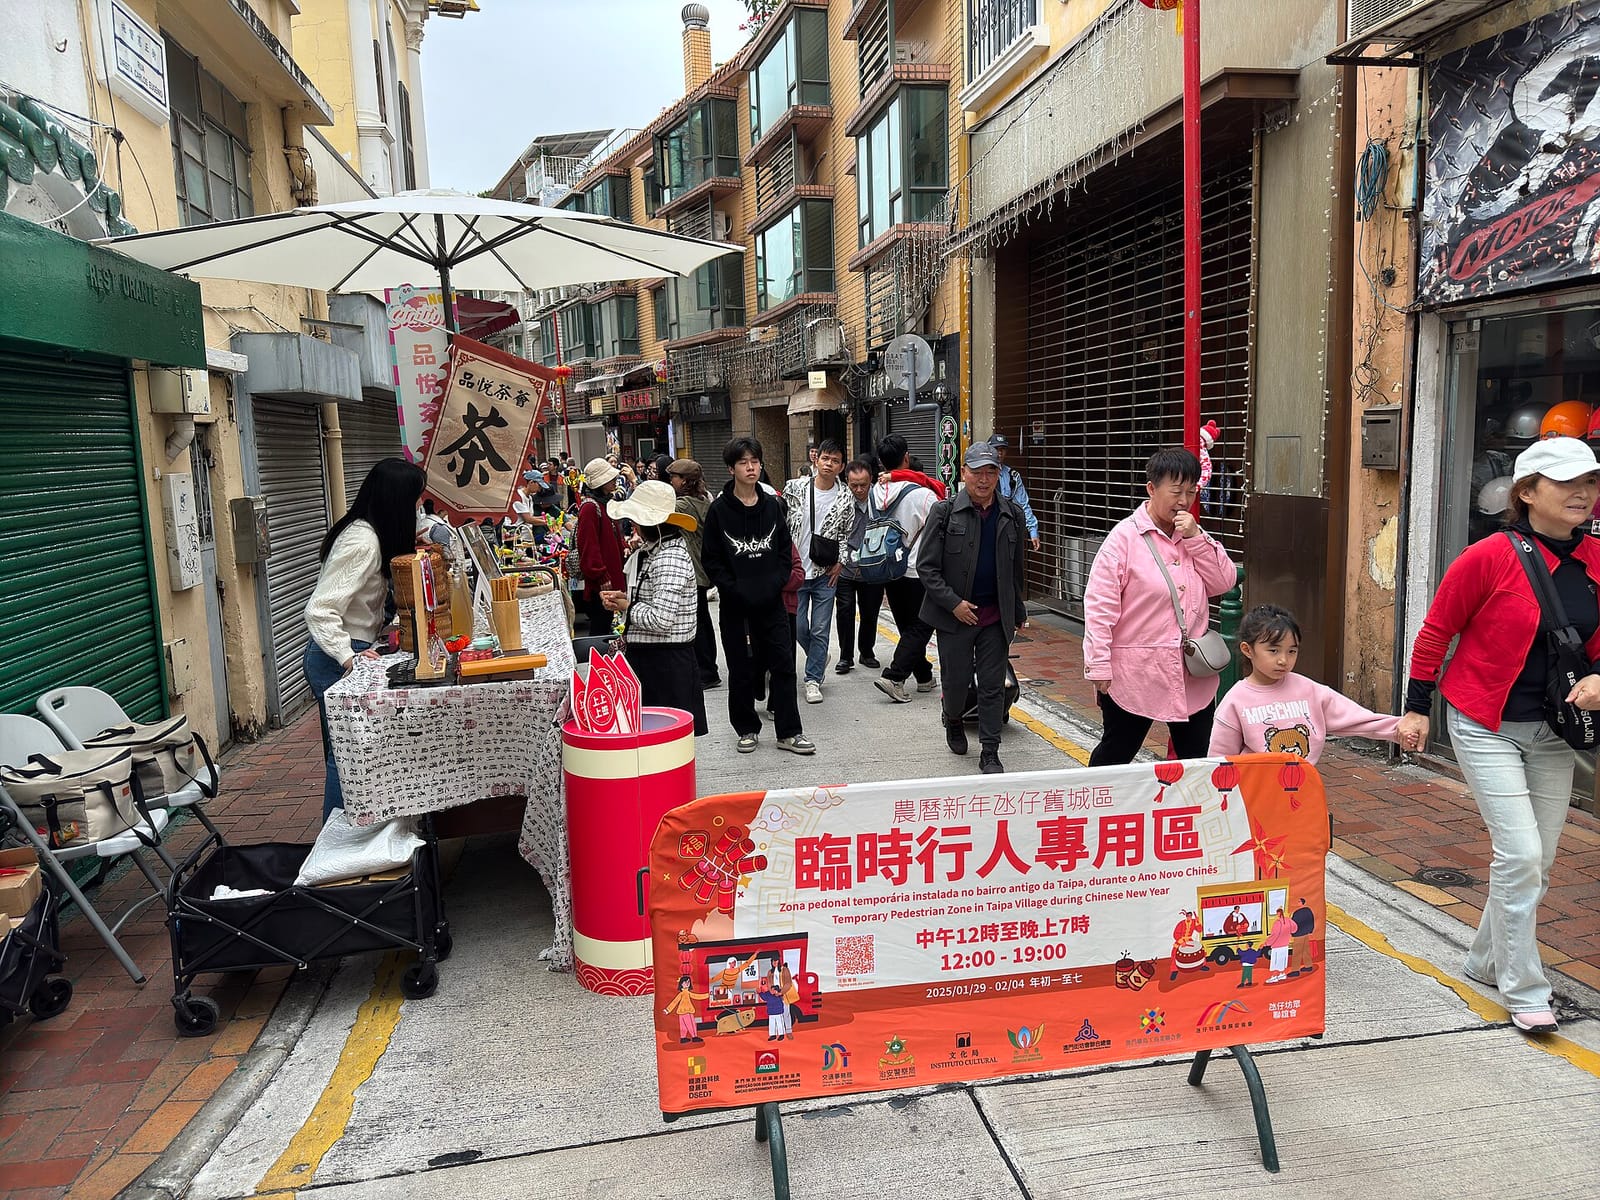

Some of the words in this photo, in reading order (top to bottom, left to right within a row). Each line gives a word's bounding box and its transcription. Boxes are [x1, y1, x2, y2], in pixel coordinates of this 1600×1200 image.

[1456, 188, 1577, 275] MOTOR
[435, 400, 512, 488] 茶
[1243, 700, 1310, 725] MOSCHINO
[892, 786, 1114, 824] 農曆新年氹仔舊城區
[794, 805, 1203, 892] 臨時行人專用區
[779, 902, 806, 913] Zona
[808, 897, 851, 911] pedonal
[853, 892, 910, 908] temporária
[912, 888, 959, 901] instalada
[961, 888, 974, 897] no
[976, 884, 1007, 896] bairro
[1009, 880, 1041, 896] antigo
[1043, 881, 1055, 891] da
[1057, 877, 1087, 891] Taipa,
[1089, 874, 1128, 887] durante
[1138, 871, 1157, 882] Ano
[1159, 869, 1184, 880] Novo
[1186, 864, 1218, 877] Chinês
[832, 911, 888, 925] Temporary
[890, 906, 945, 920] Pedestrian
[947, 904, 972, 915] Zone
[974, 902, 984, 912] in
[986, 900, 1013, 914] Taipa
[1015, 893, 1048, 909] Village
[1050, 892, 1083, 907] during
[1085, 891, 1124, 903] Chinese
[1126, 888, 1147, 899] New
[1148, 886, 1170, 897] Year
[916, 915, 1090, 950] 中午12時至晚上7時
[941, 949, 995, 971] 12:00
[1012, 942, 1067, 964] 19:00
[926, 982, 986, 999] 2025/01/29
[995, 978, 1025, 992] 02/04
[1029, 972, 1083, 988] 年初一至七
[930, 1060, 964, 1069] INSTITUTO
[964, 1056, 998, 1066] CULTURAL
[949, 1049, 979, 1060] 文化局
[688, 1090, 713, 1099] DSEDT
